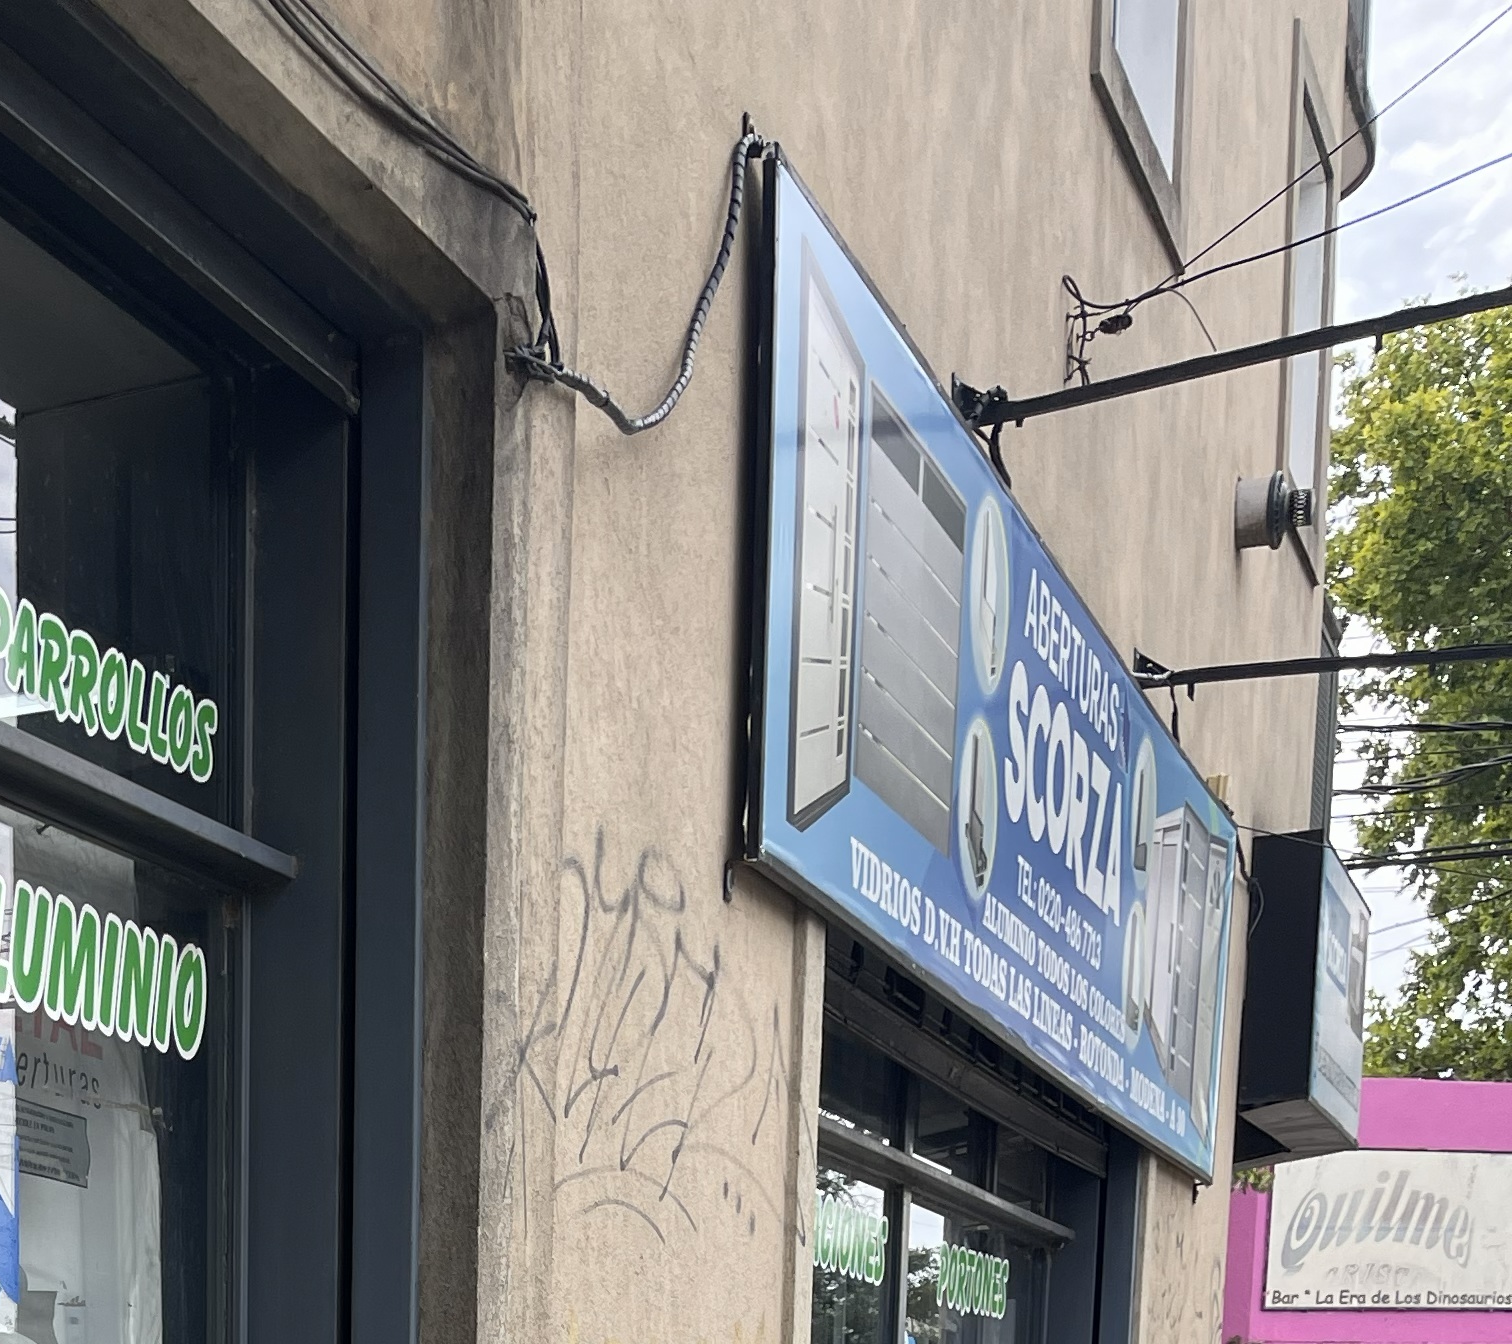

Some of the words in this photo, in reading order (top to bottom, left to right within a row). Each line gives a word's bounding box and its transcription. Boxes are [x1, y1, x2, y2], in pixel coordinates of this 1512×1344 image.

[1024, 567, 1121, 753] ABERTURAS
[1004, 660, 1122, 927] SCORZA
[850, 835, 922, 936] VIDRIOS
[963, 928, 1007, 1002] TODAS
[1008, 966, 1032, 1020] LAS
[1032, 985, 1073, 1052] LINEAS
[1078, 1023, 1125, 1093] ROTONDA
[982, 891, 1036, 967] ALUMINIO
[1037, 938, 1070, 996] TODOS
[1070, 968, 1088, 1012] LOS
[1089, 985, 1126, 1045] COLORES
[937, 1241, 1009, 1320] PORTONES
[1271, 1289, 1299, 1305] Bar
[1315, 1289, 1334, 1305] La
[1339, 1289, 1366, 1305] Era
[1370, 1289, 1391, 1305] de
[1395, 1289, 1421, 1305] Los
[1426, 1289, 1512, 1305] Dinosaurios
